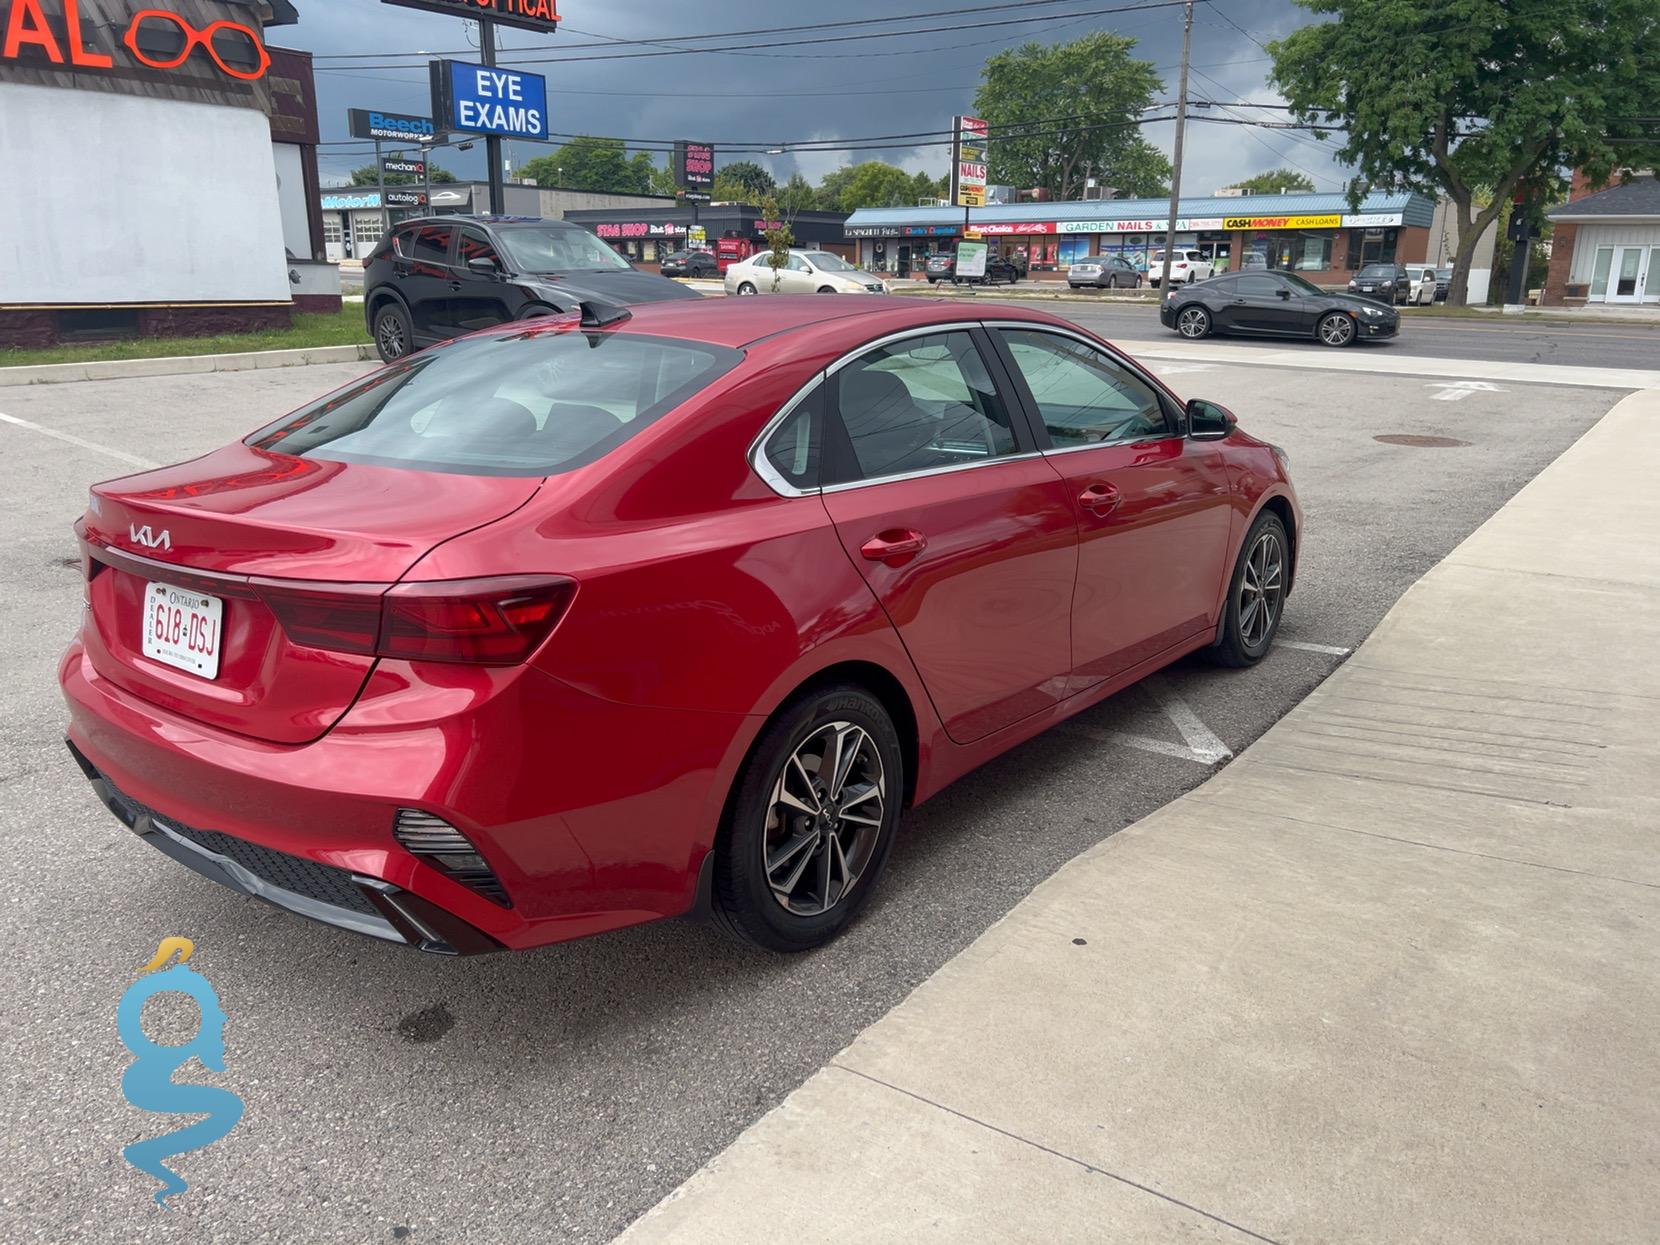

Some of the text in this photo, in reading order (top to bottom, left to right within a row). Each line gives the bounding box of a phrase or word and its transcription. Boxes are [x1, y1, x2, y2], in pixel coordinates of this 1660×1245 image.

[476, 70, 522, 101] EYE
[368, 111, 435, 134] Beech
[459, 100, 541, 134] EXAMS
[960, 163, 985, 179] NAILS
[988, 224, 1013, 232] Choice
[1065, 222, 1114, 232] GARDEN
[1117, 221, 1153, 230] NAILS
[1296, 218, 1315, 226] CASH
[597, 224, 620, 237] STAG
[621, 223, 648, 236] SHOP
